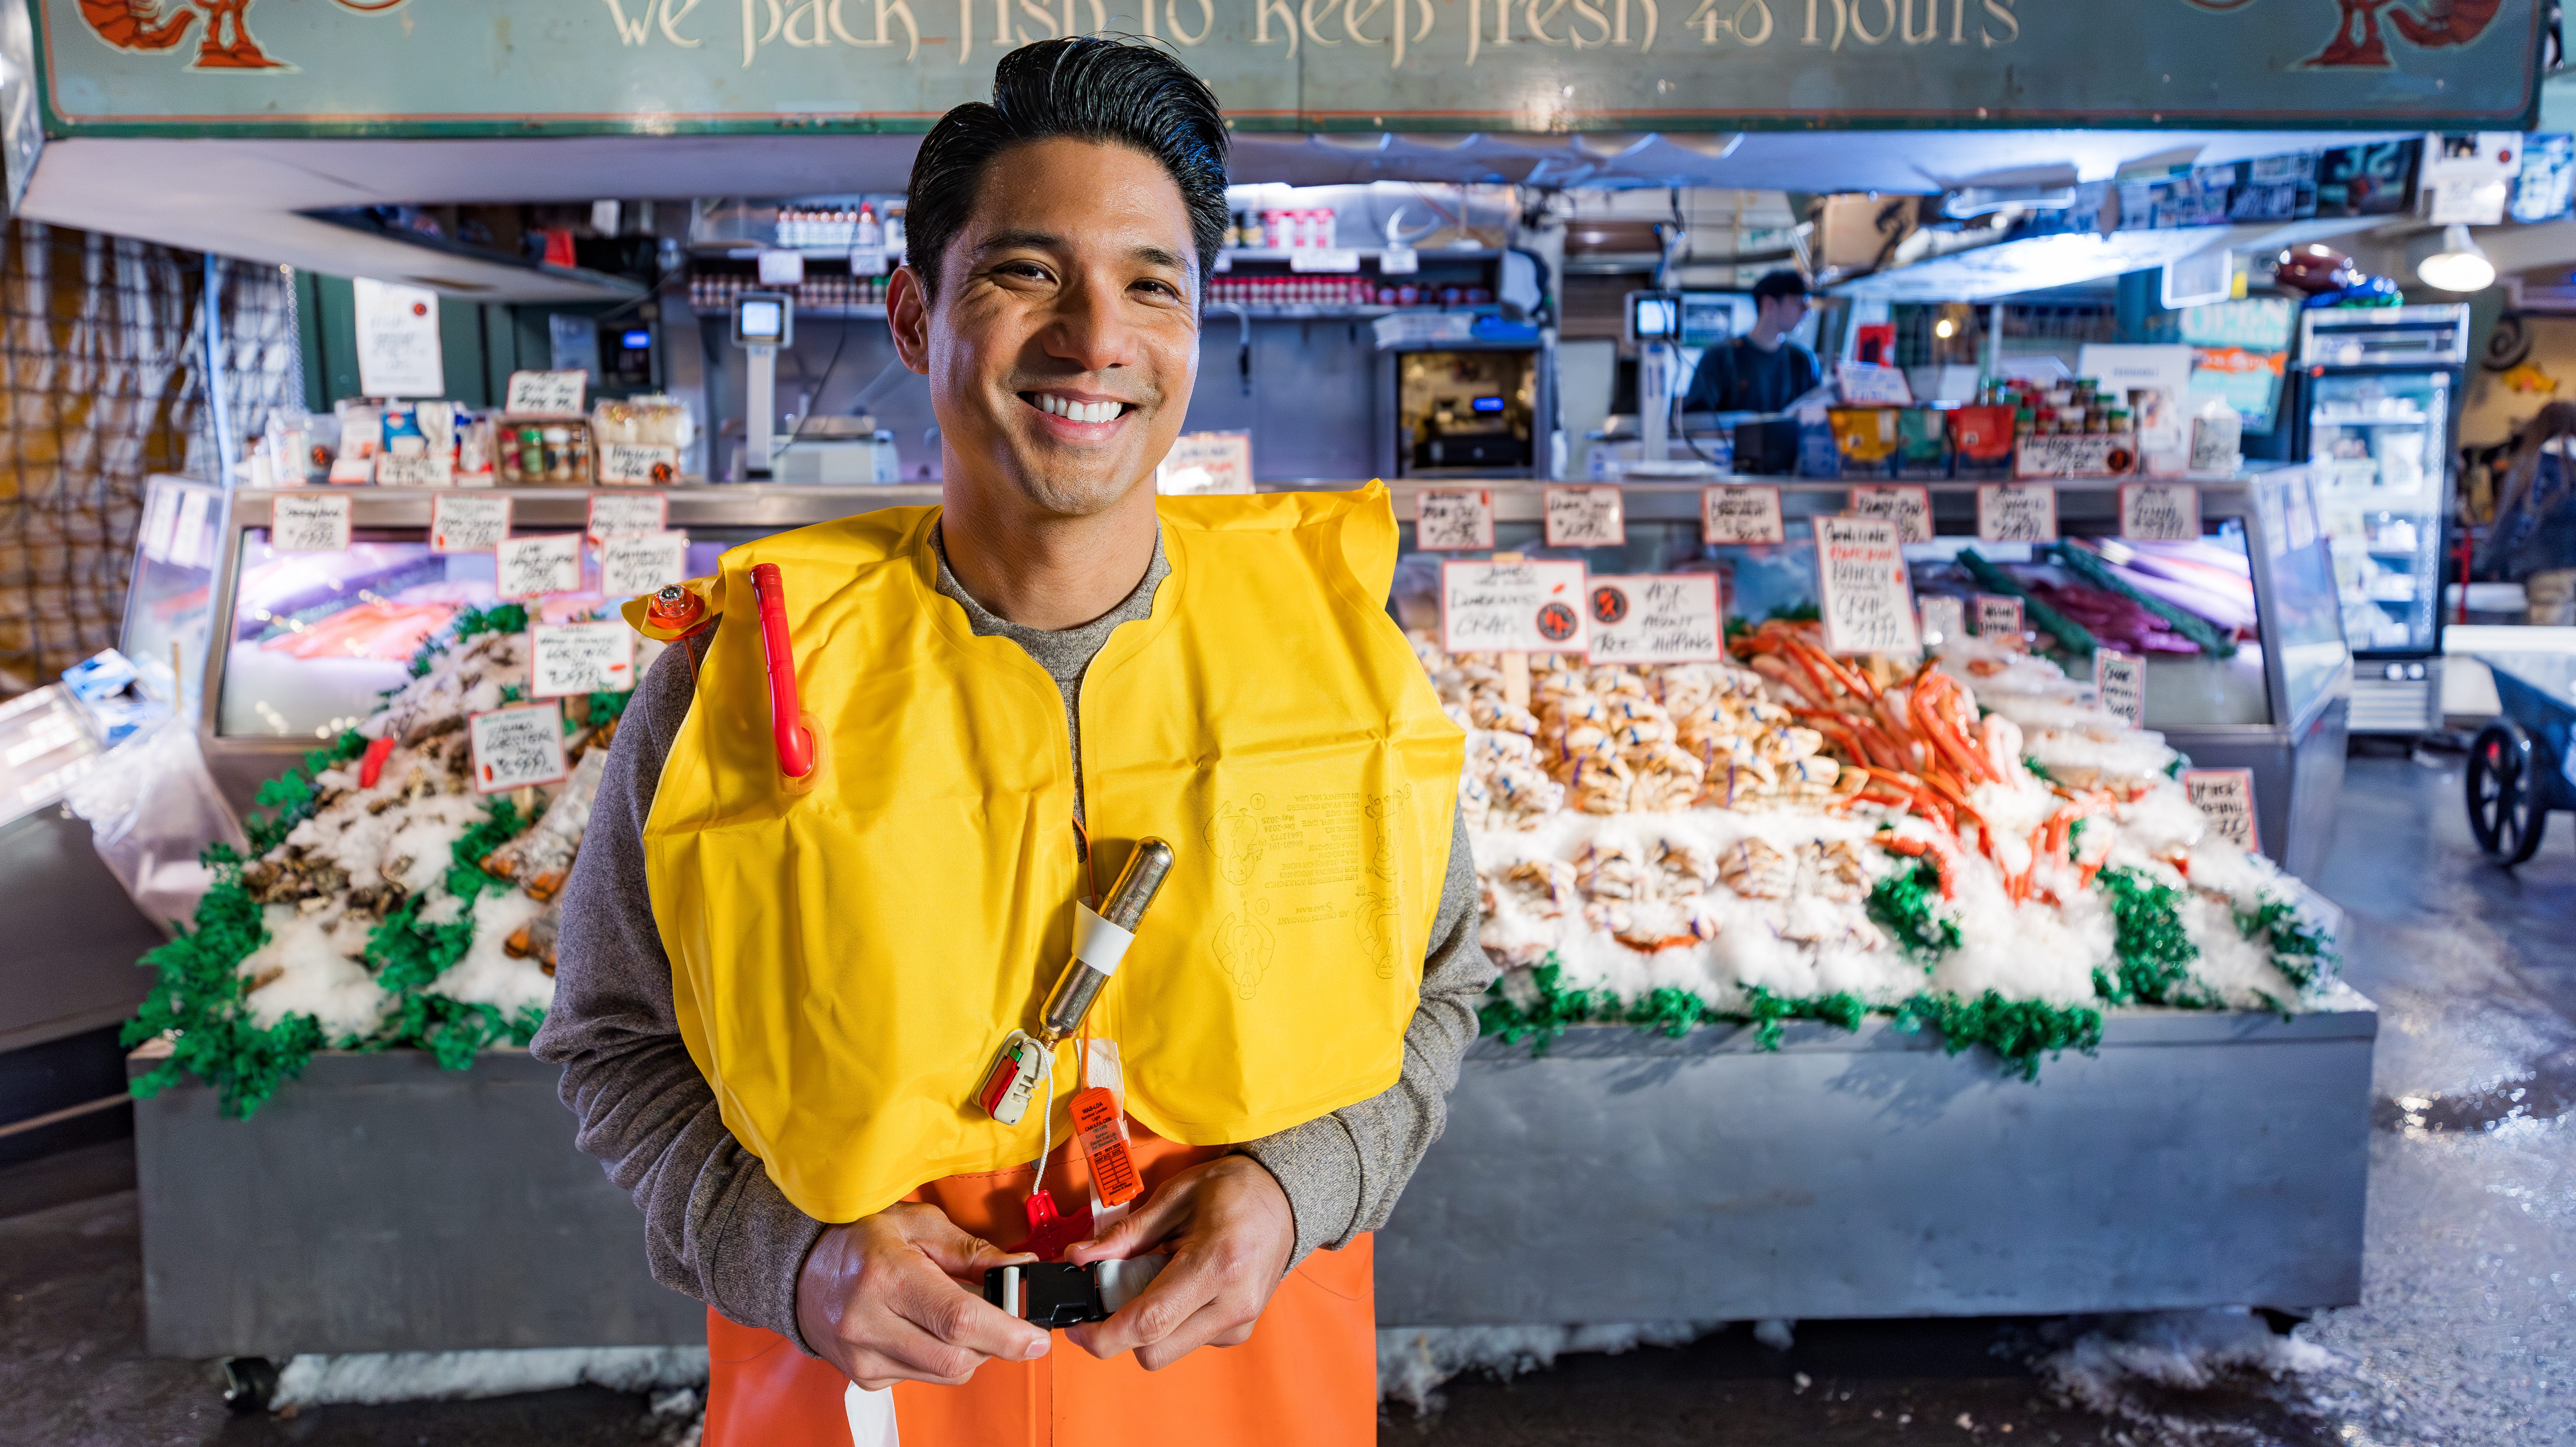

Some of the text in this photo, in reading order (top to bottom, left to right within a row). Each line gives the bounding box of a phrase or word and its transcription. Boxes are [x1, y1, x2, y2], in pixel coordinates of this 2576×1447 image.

[1280, 870, 1314, 878] WEIGHING
[1316, 867, 1343, 876] PERSONS
[1308, 875, 1343, 885] PRESERVER
[1277, 917, 1309, 925] COMPANY
[1312, 913, 1336, 921] CRUISERS
